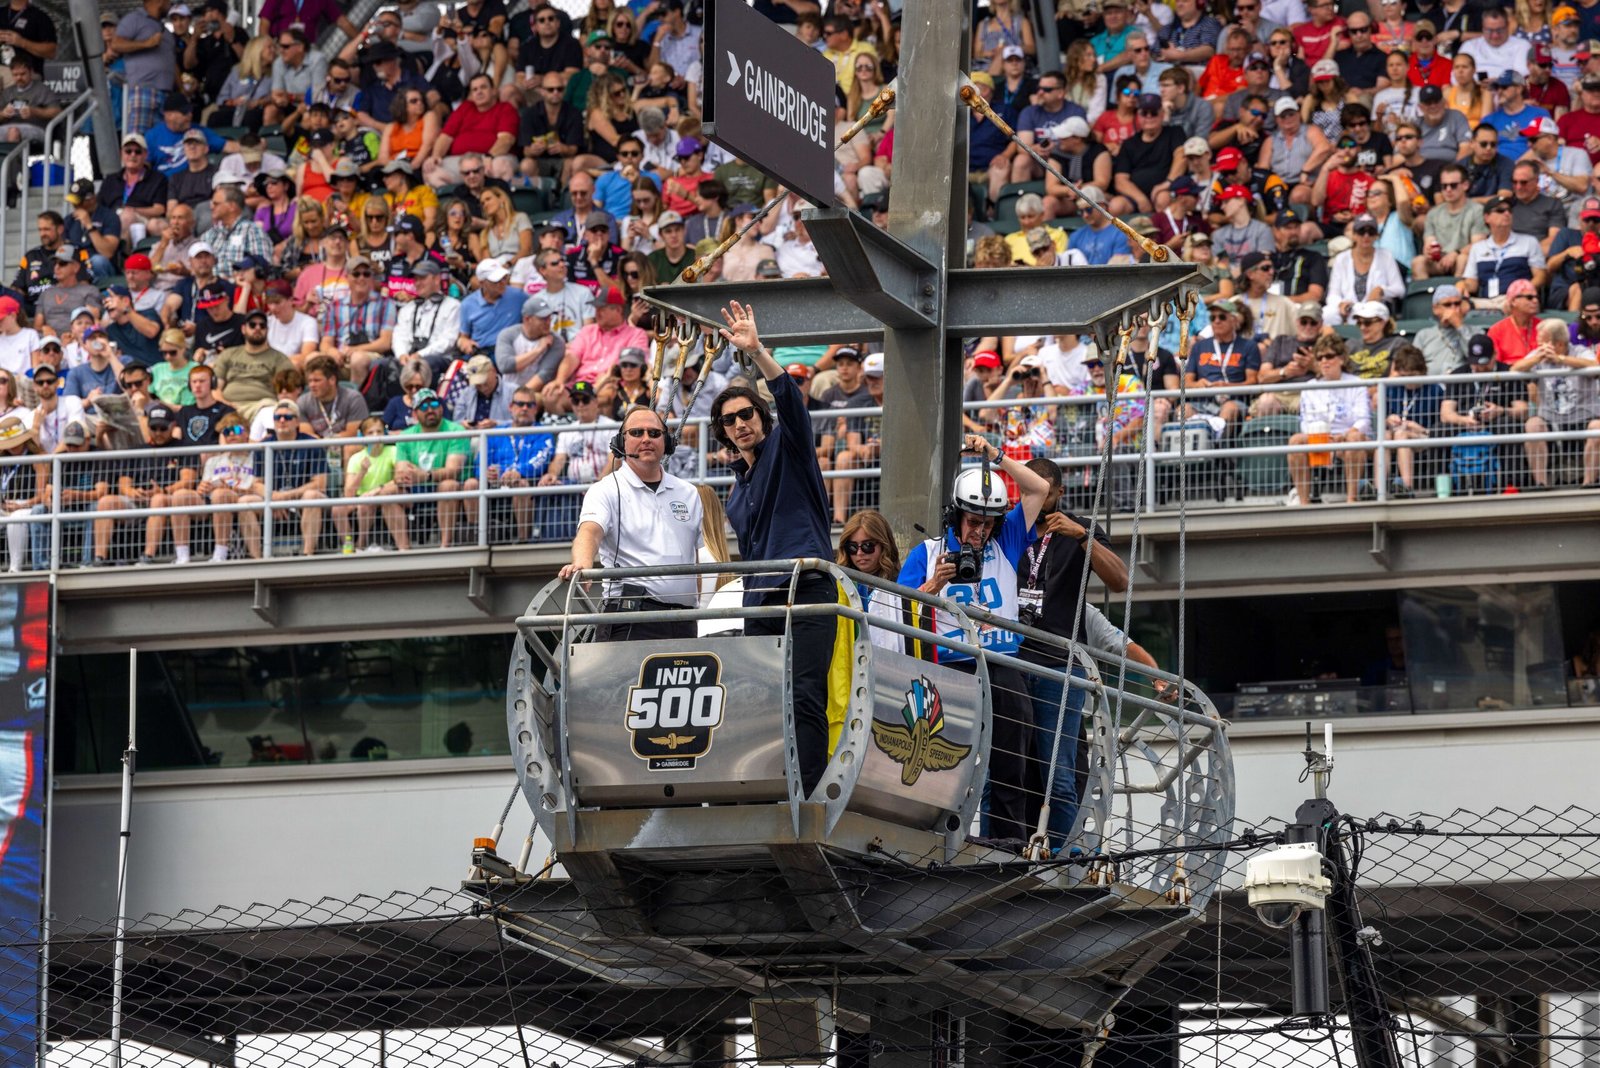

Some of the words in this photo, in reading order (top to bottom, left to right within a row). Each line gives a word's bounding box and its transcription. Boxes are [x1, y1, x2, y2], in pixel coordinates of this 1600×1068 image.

[62, 66, 81, 80] NO
[744, 59, 827, 149] GAINBRIDGE
[947, 577, 1003, 610] 30
[655, 666, 708, 686] INDY
[628, 686, 723, 729] 500
[879, 733, 913, 750] INDIANAPOLIS
[911, 727, 929, 777] MOTOR
[929, 748, 955, 764] SPEEDWAY
[661, 760, 690, 768] GAINBRIDGE
